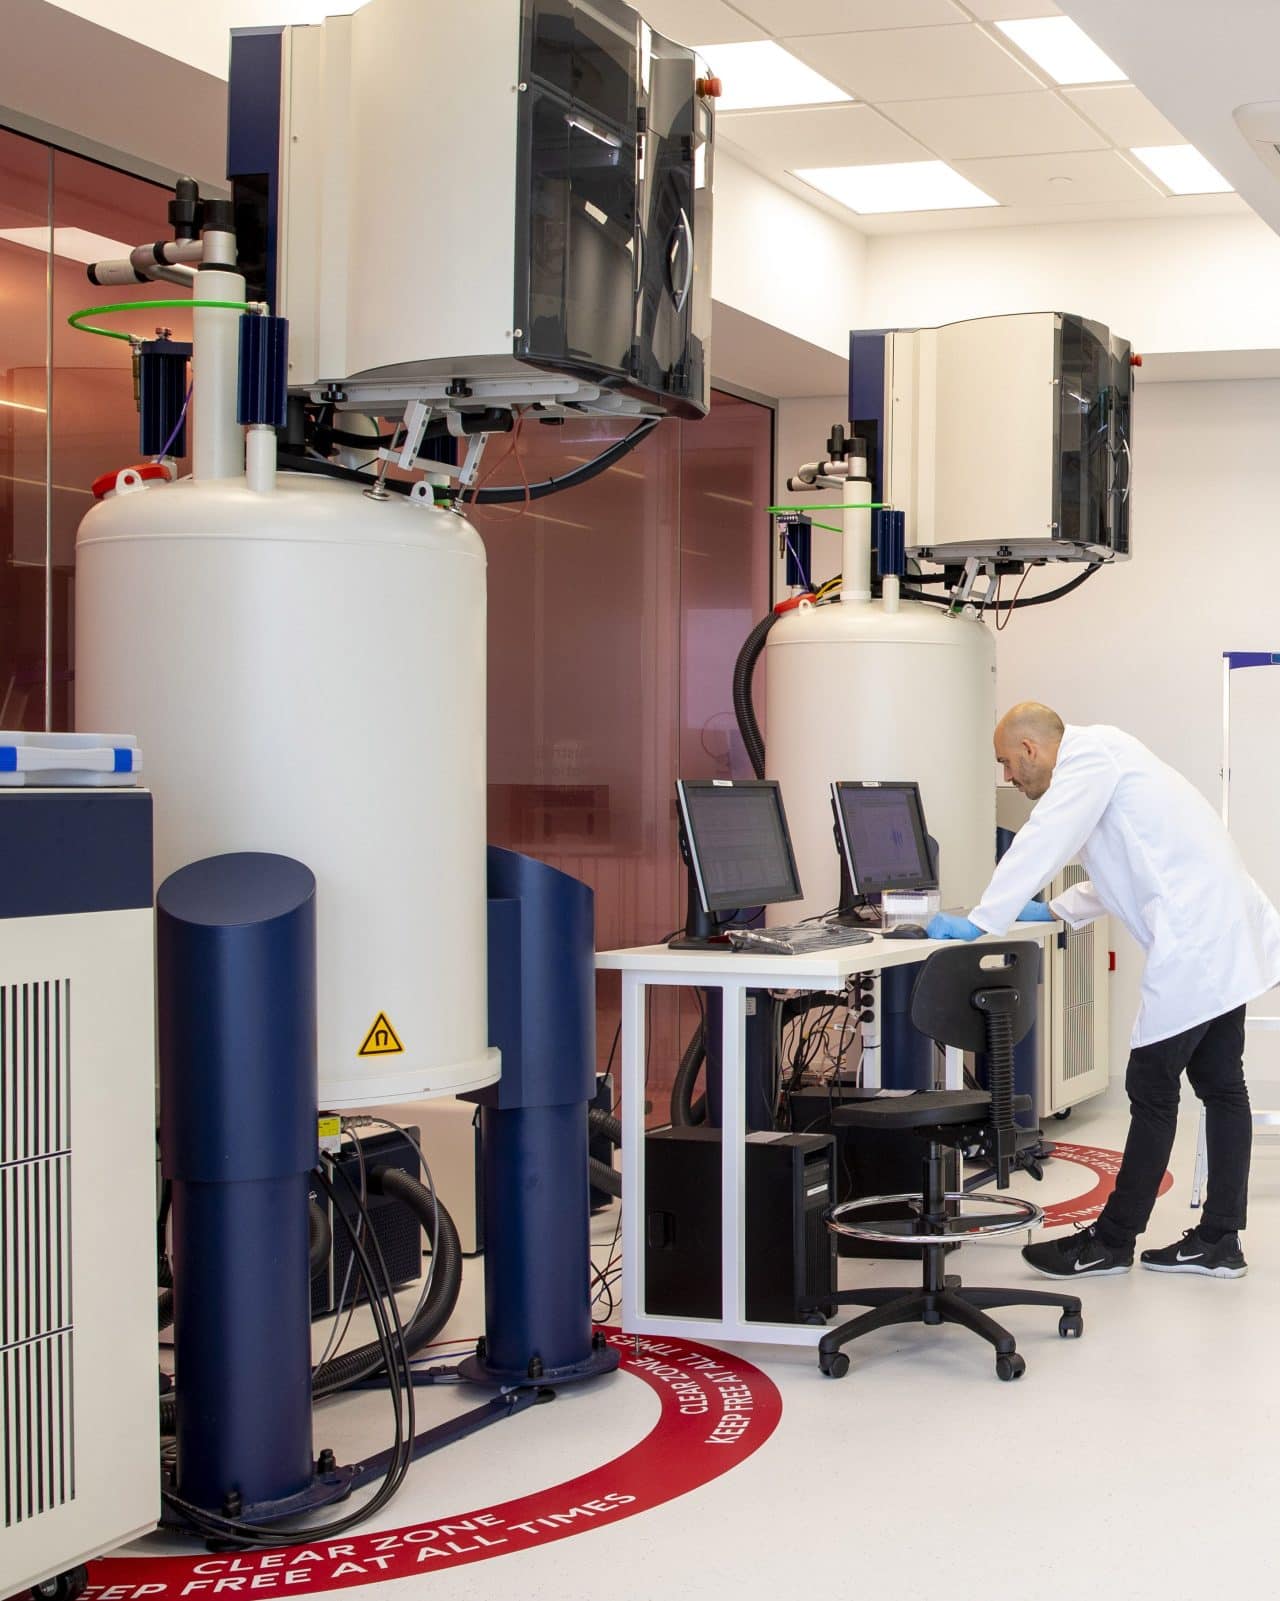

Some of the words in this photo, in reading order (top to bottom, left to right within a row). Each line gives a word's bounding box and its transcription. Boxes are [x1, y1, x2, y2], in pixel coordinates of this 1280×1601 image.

[626, 1356, 691, 1383] ZONE
[677, 1352, 725, 1370] ALL
[703, 1370, 743, 1383] AT
[671, 1380, 709, 1415] CLEAR
[718, 1383, 754, 1412] FREE
[704, 1412, 752, 1444] KEEP
[76, 1582, 168, 1601] EEP
[181, 1568, 311, 1596] FREE
[331, 1554, 395, 1578] AT
[416, 1534, 507, 1562] ALL
[507, 1492, 636, 1534] TIMES
[193, 1544, 357, 1575] CLEAR
[370, 1514, 505, 1551] ZONE
